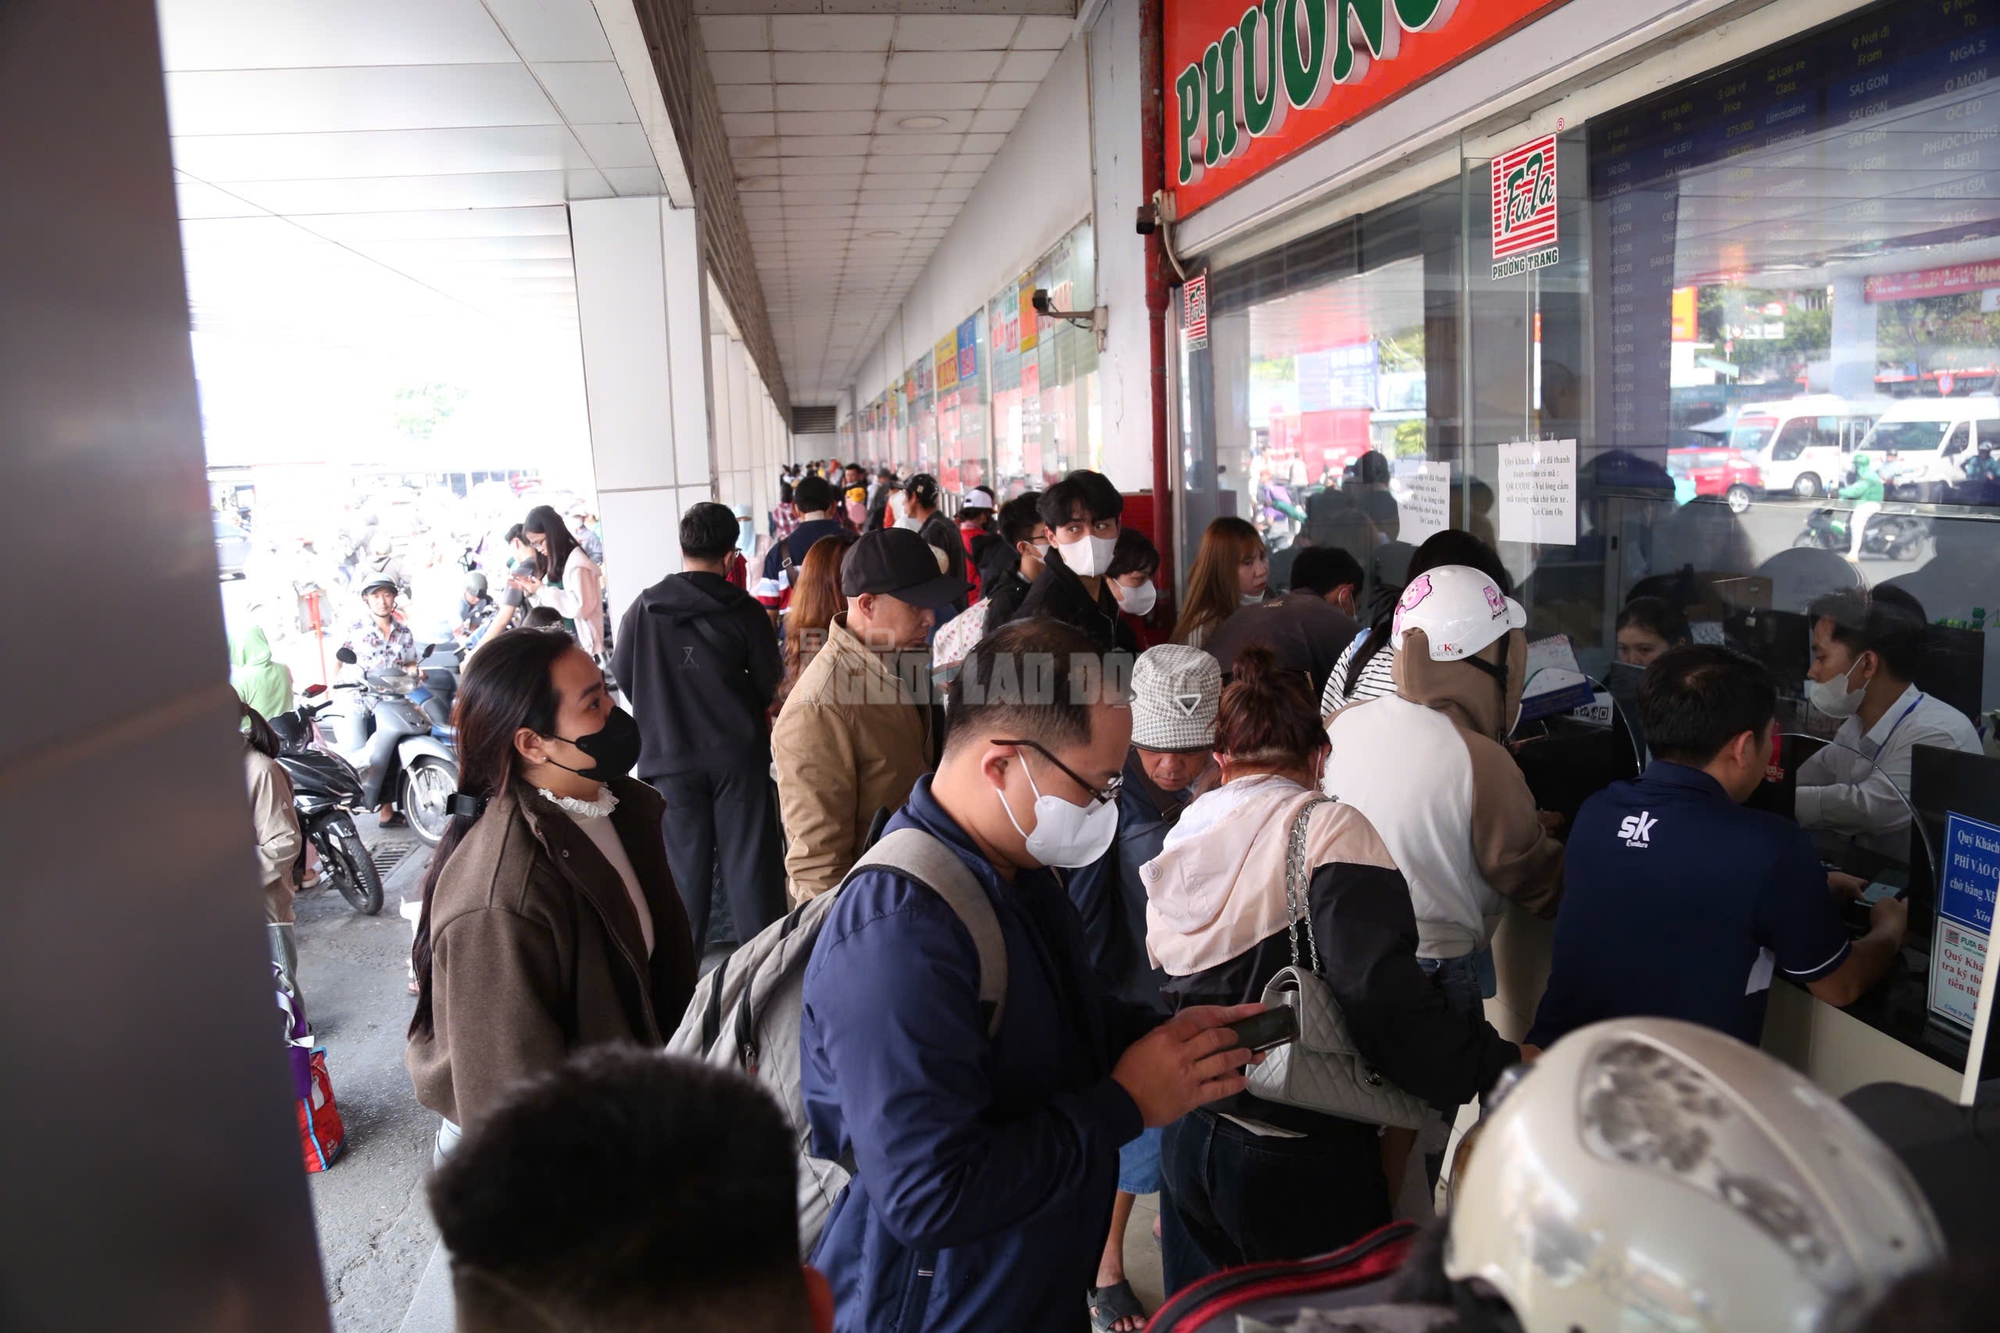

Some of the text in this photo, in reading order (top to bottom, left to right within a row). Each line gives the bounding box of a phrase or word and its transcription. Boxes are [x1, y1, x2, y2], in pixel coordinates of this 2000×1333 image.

[1492, 246, 1559, 280] PHƯƠNG TRANG
[1437, 643, 1458, 652] CKC
[1957, 829, 1974, 848] Quý
[1953, 853, 1970, 870] PHÍ
[1971, 858, 1991, 876] VÀO
[1973, 907, 1991, 923] Xin
[1960, 936, 1977, 949] FUTA
[1944, 948, 1963, 964] Quý
[1942, 961, 1955, 974] tra
